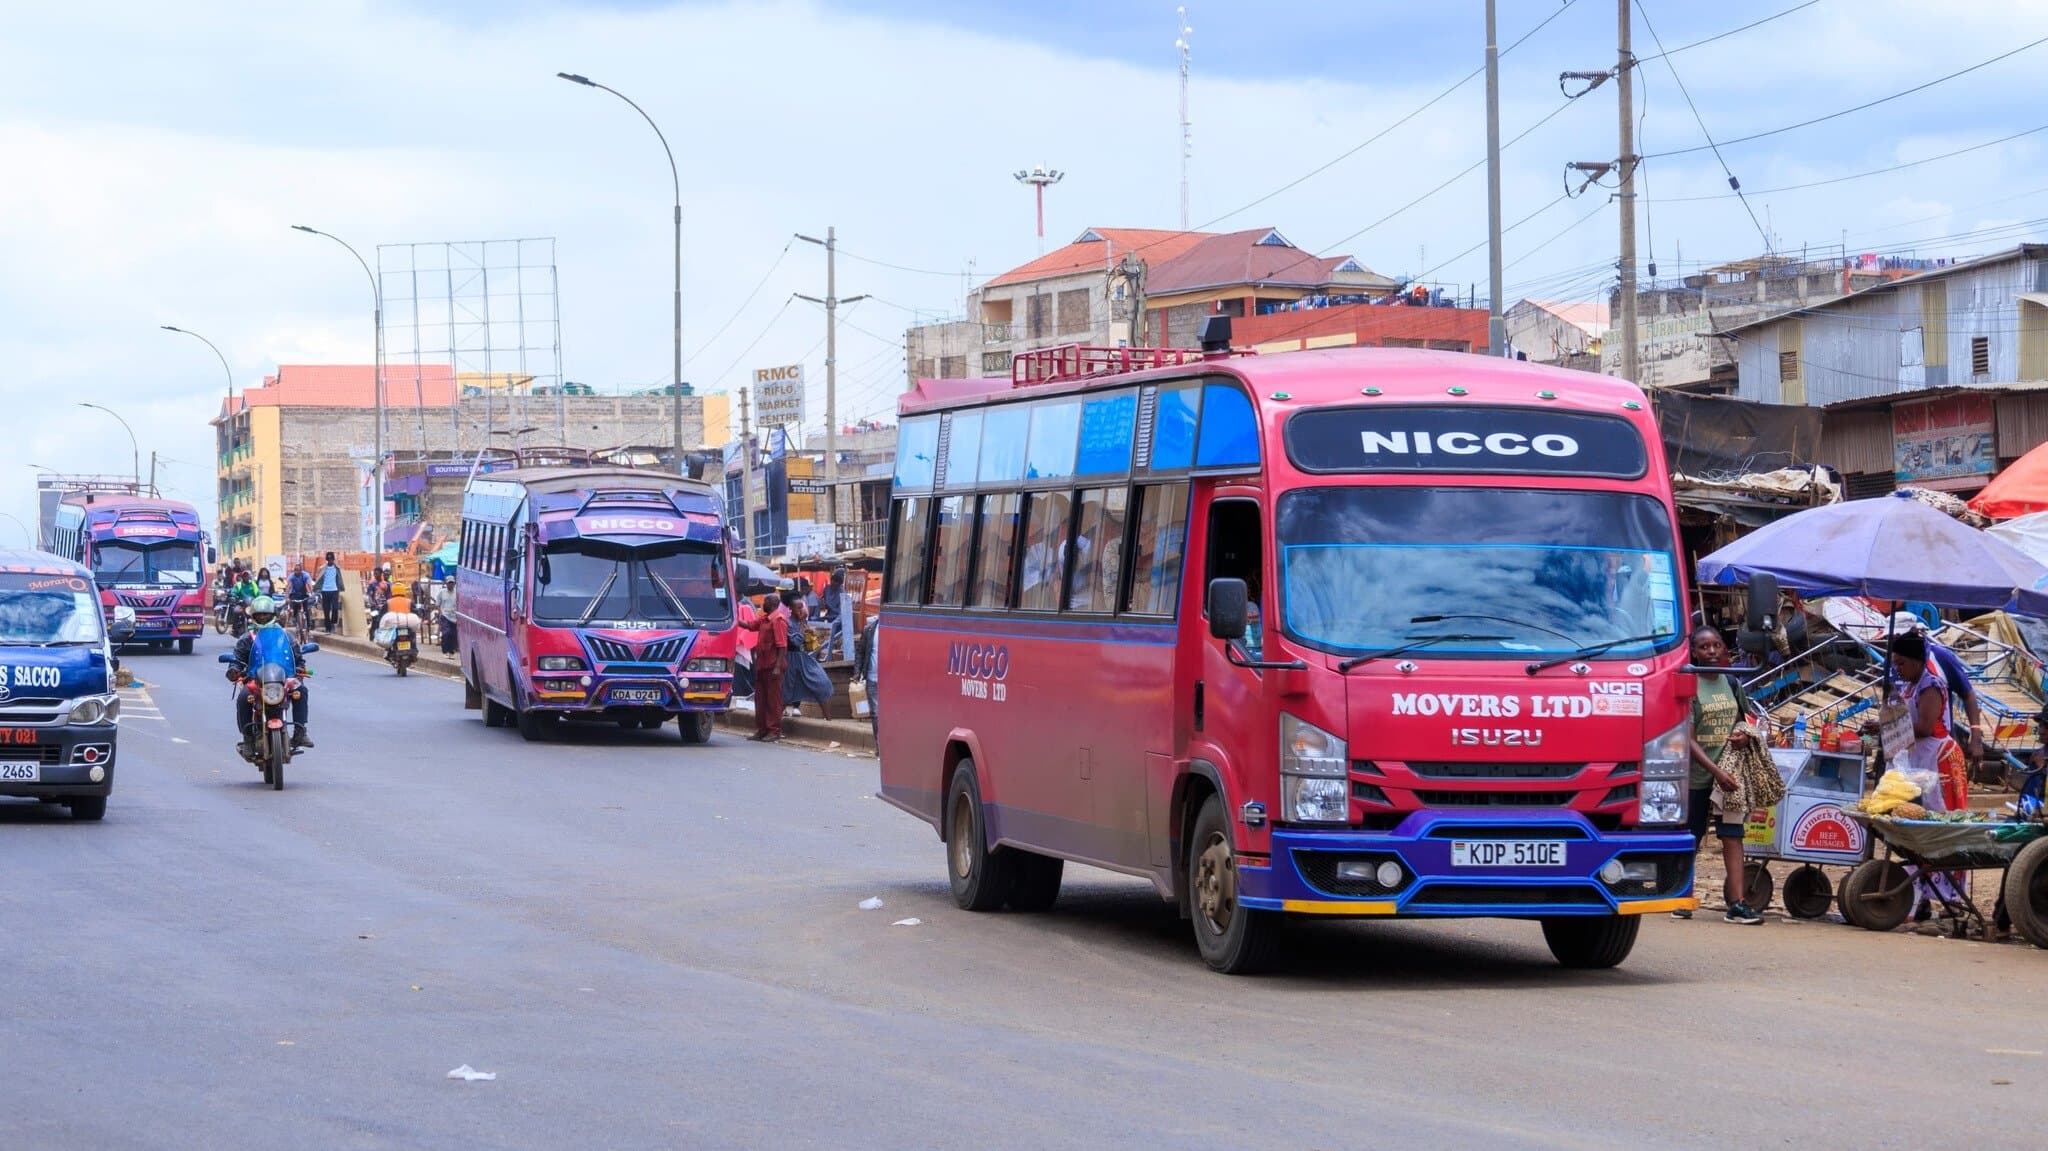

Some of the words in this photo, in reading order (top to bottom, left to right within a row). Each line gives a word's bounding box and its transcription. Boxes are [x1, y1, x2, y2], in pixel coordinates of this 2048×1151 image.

[757, 365, 799, 381] RMC
[758, 398, 800, 410] MARKET
[759, 412, 799, 424] CENTRE
[1361, 431, 1579, 457] NICCO
[434, 465, 468, 473] SOUTHERN
[792, 486, 825, 494] TEXTILES
[123, 527, 169, 535] NICCO
[591, 519, 675, 530] NICCO
[613, 621, 657, 629] ISUZU
[948, 641, 1009, 680] NICCO
[15, 665, 61, 688] SACCO
[612, 690, 632, 699] KDA
[635, 690, 660, 699] 024T
[961, 678, 988, 699] MOVERS
[992, 682, 1007, 702] LTD
[1589, 682, 1643, 696] NQR
[1392, 693, 1520, 717] MOVERS
[1531, 695, 1593, 718] LTD
[16, 729, 37, 743] 021
[1452, 728, 1542, 746] ISUZU
[3, 765, 33, 779] 246S
[1796, 810, 1832, 842] Farmer's
[1834, 811, 1857, 846] Choice
[1819, 831, 1838, 840] BEEF
[1811, 840, 1845, 848] SAUSAGES
[1470, 843, 1506, 864] KDP
[1514, 843, 1560, 864] 510E
